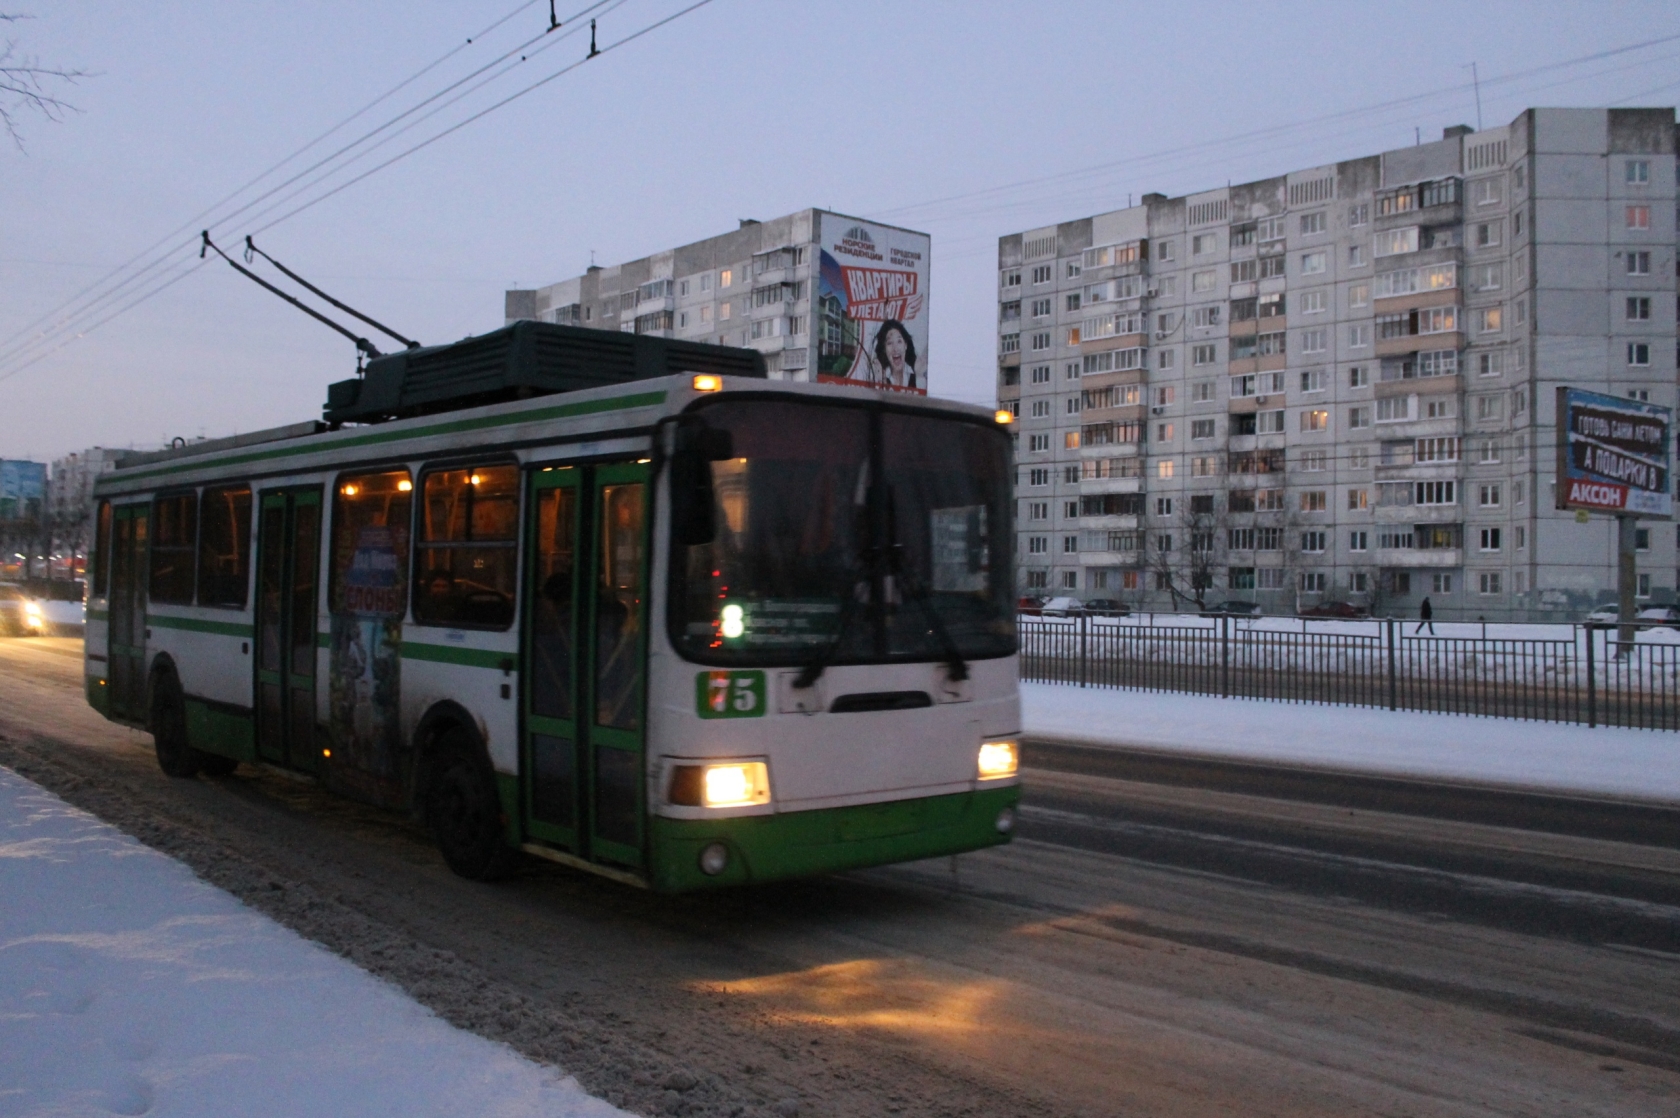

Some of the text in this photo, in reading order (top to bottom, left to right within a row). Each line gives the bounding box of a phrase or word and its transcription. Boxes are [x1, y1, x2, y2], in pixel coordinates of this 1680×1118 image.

[834, 245, 883, 261] РЕЗИДЕНЦИИ
[842, 238, 876, 252] НОРСКИЕ
[890, 247, 922, 260] ГОРОДСКОЙ
[890, 257, 915, 268] КВАРТАЛ
[847, 269, 915, 302] КВАРТИРЫ
[850, 300, 903, 320] УЛЕТАЮТ
[1578, 415, 1609, 437] ГОТОВЬ
[1611, 420, 1633, 440] САНИ
[1584, 446, 1657, 490] А ПОДАРКИ В
[1570, 482, 1621, 506] АКСОН
[708, 678, 757, 712] 75
